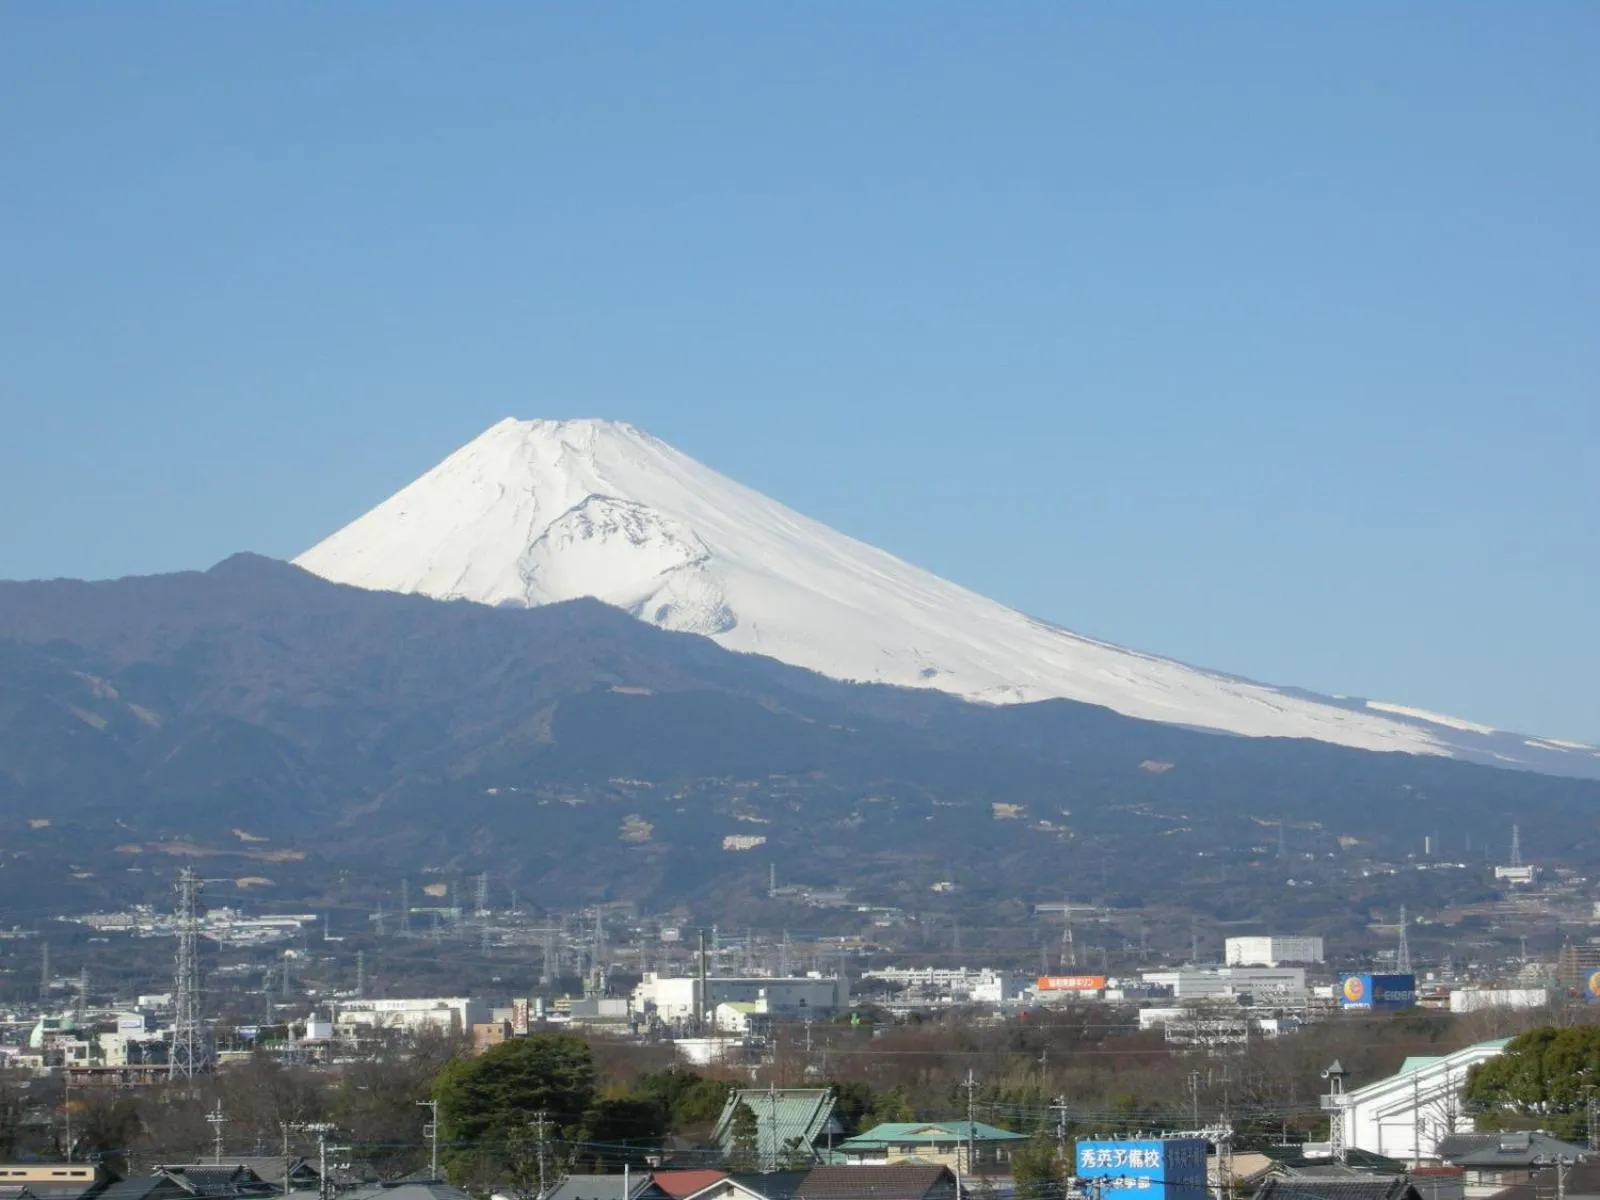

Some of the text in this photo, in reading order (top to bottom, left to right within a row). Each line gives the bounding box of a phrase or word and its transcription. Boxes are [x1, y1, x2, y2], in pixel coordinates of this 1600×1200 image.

[1080, 1148, 1160, 1169] 秀英予備校
